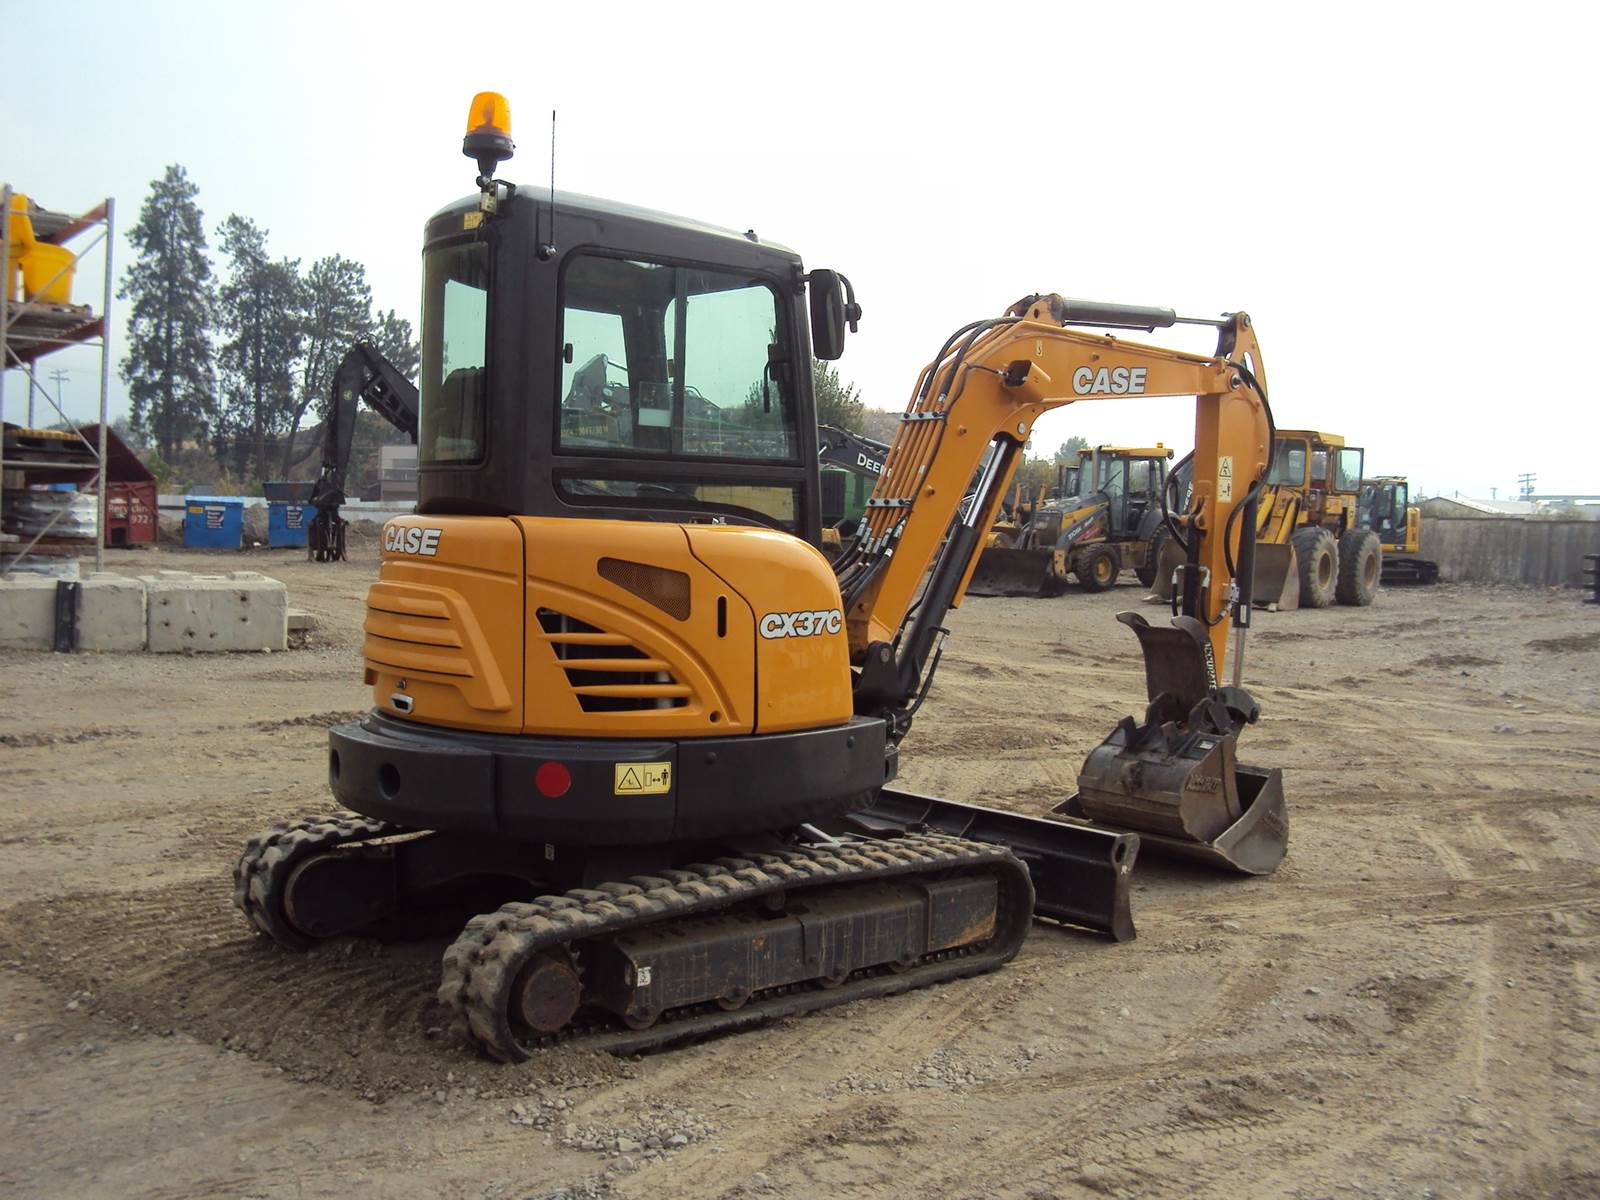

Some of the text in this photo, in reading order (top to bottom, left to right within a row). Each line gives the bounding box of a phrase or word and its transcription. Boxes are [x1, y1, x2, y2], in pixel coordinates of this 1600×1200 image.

[1072, 366, 1146, 395] CASE
[384, 524, 443, 557] CASE
[759, 609, 842, 639] CX37C
